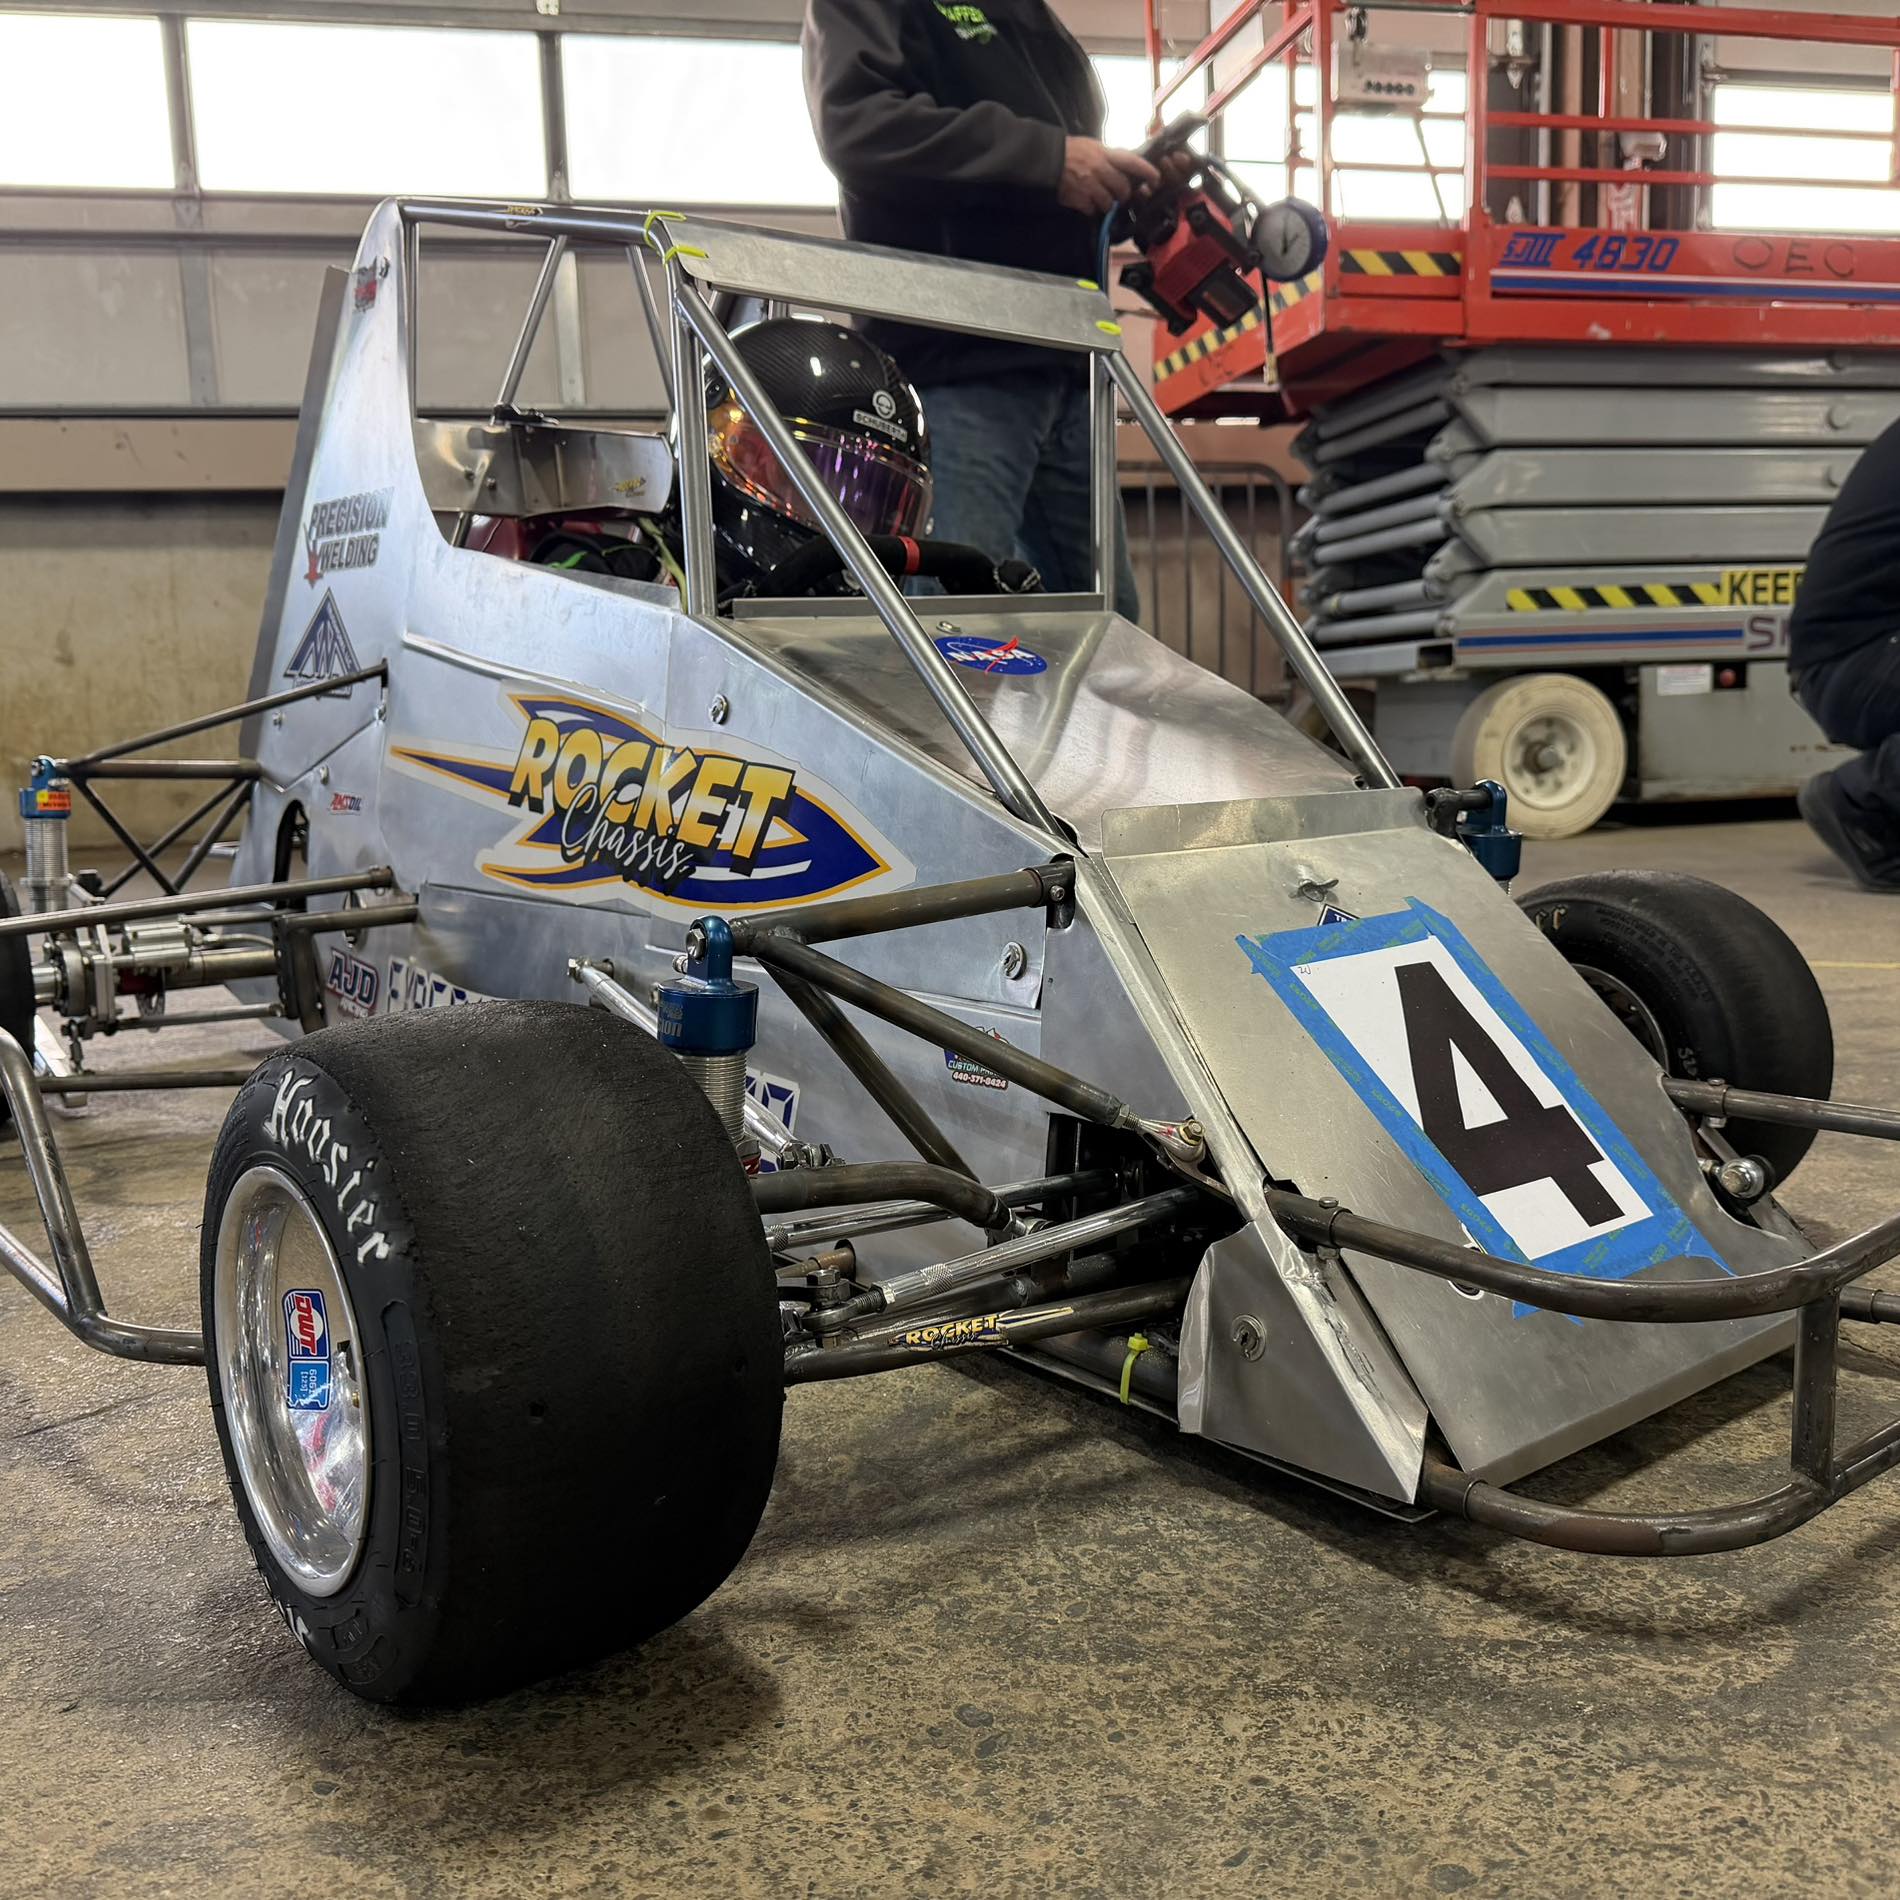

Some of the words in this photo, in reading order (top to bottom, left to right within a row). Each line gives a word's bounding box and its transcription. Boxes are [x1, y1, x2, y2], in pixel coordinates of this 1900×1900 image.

[1571, 235, 1680, 272] 4830
[308, 486, 394, 540] PRECISION
[320, 532, 380, 574] WELDING
[509, 717, 796, 868] ROCKET
[561, 782, 695, 880] Chassis
[328, 953, 377, 1006] AJD
[948, 1060, 979, 1073] CUSTOM
[1395, 961, 1625, 1228] 4
[263, 1070, 390, 1264] Hoosier
[294, 1293, 318, 1356] DWT
[905, 1314, 999, 1345] ROCKET
